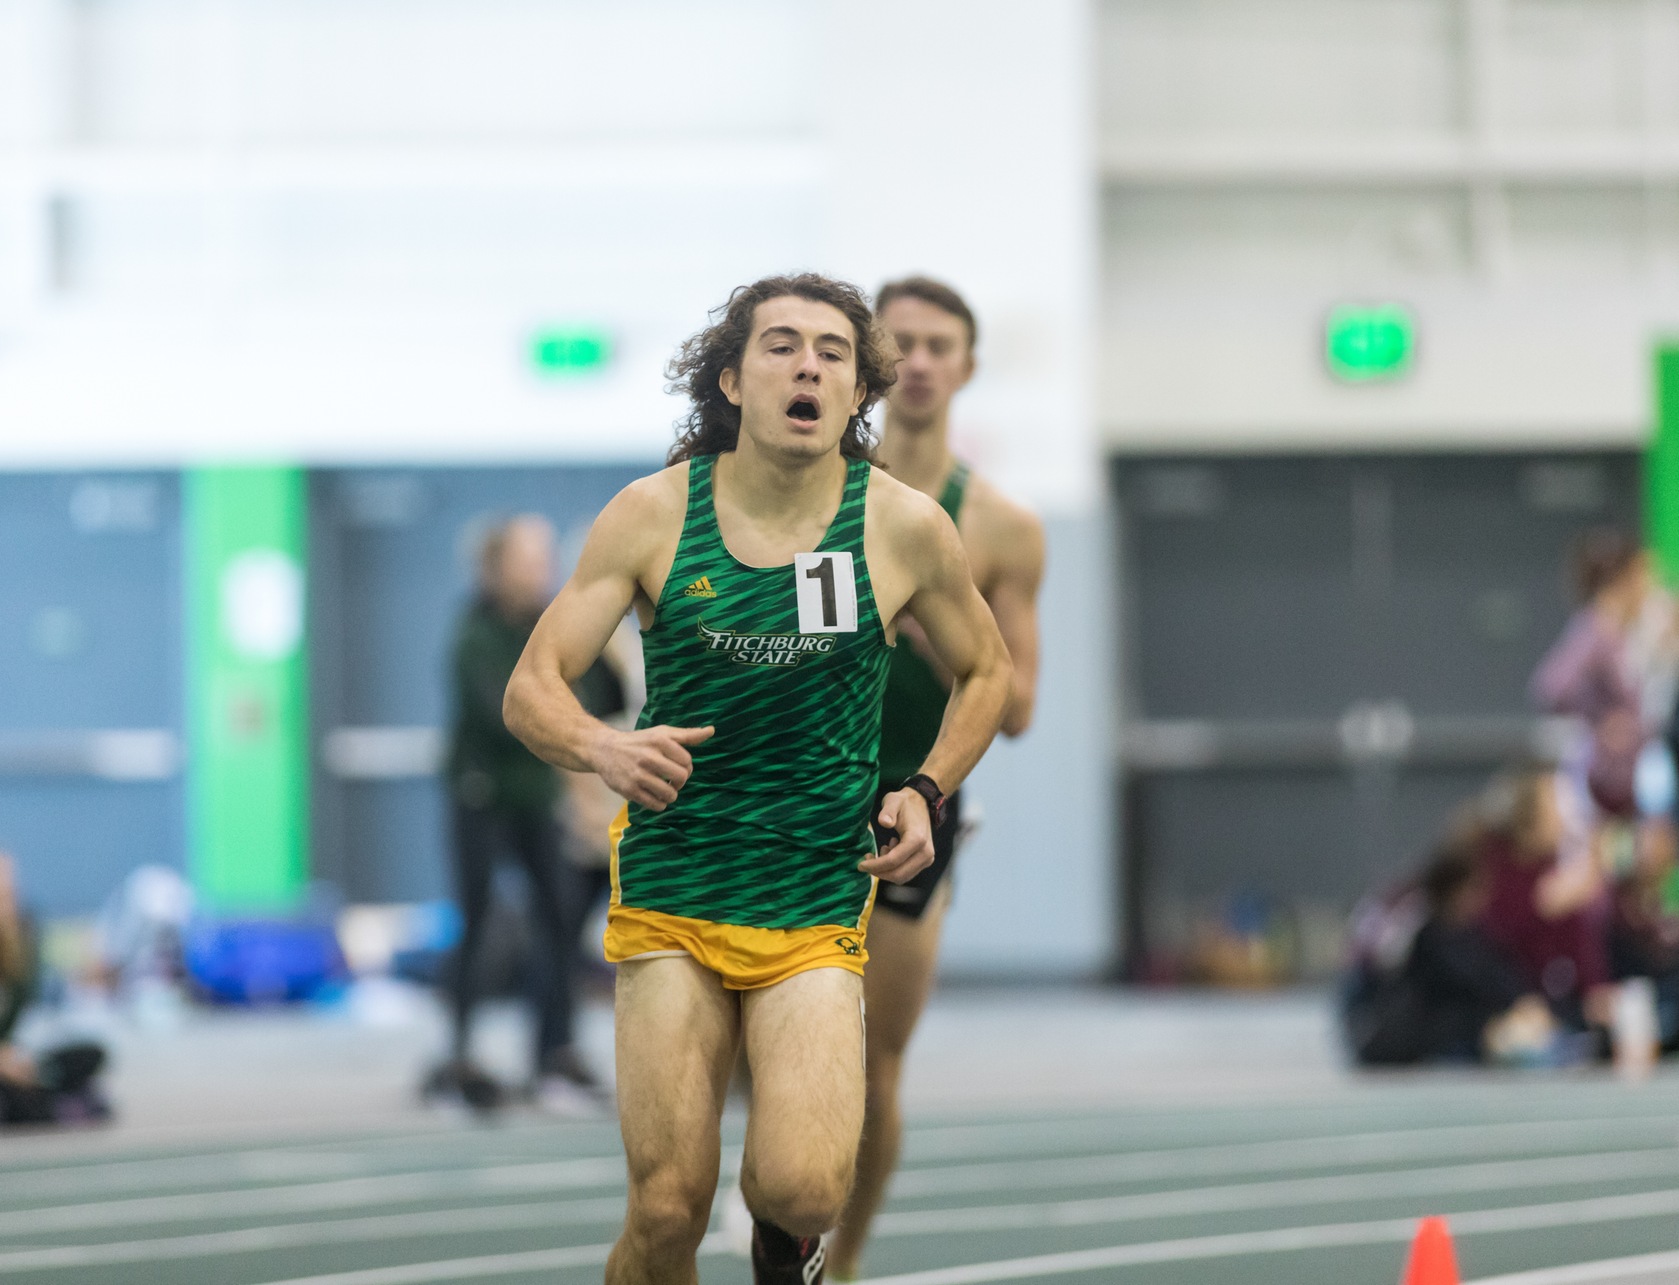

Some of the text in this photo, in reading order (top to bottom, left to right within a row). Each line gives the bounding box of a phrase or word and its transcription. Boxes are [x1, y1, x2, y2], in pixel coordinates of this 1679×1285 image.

[684, 588, 717, 598] adidas
[806, 557, 837, 627] 1
[731, 650, 801, 665] STATE
